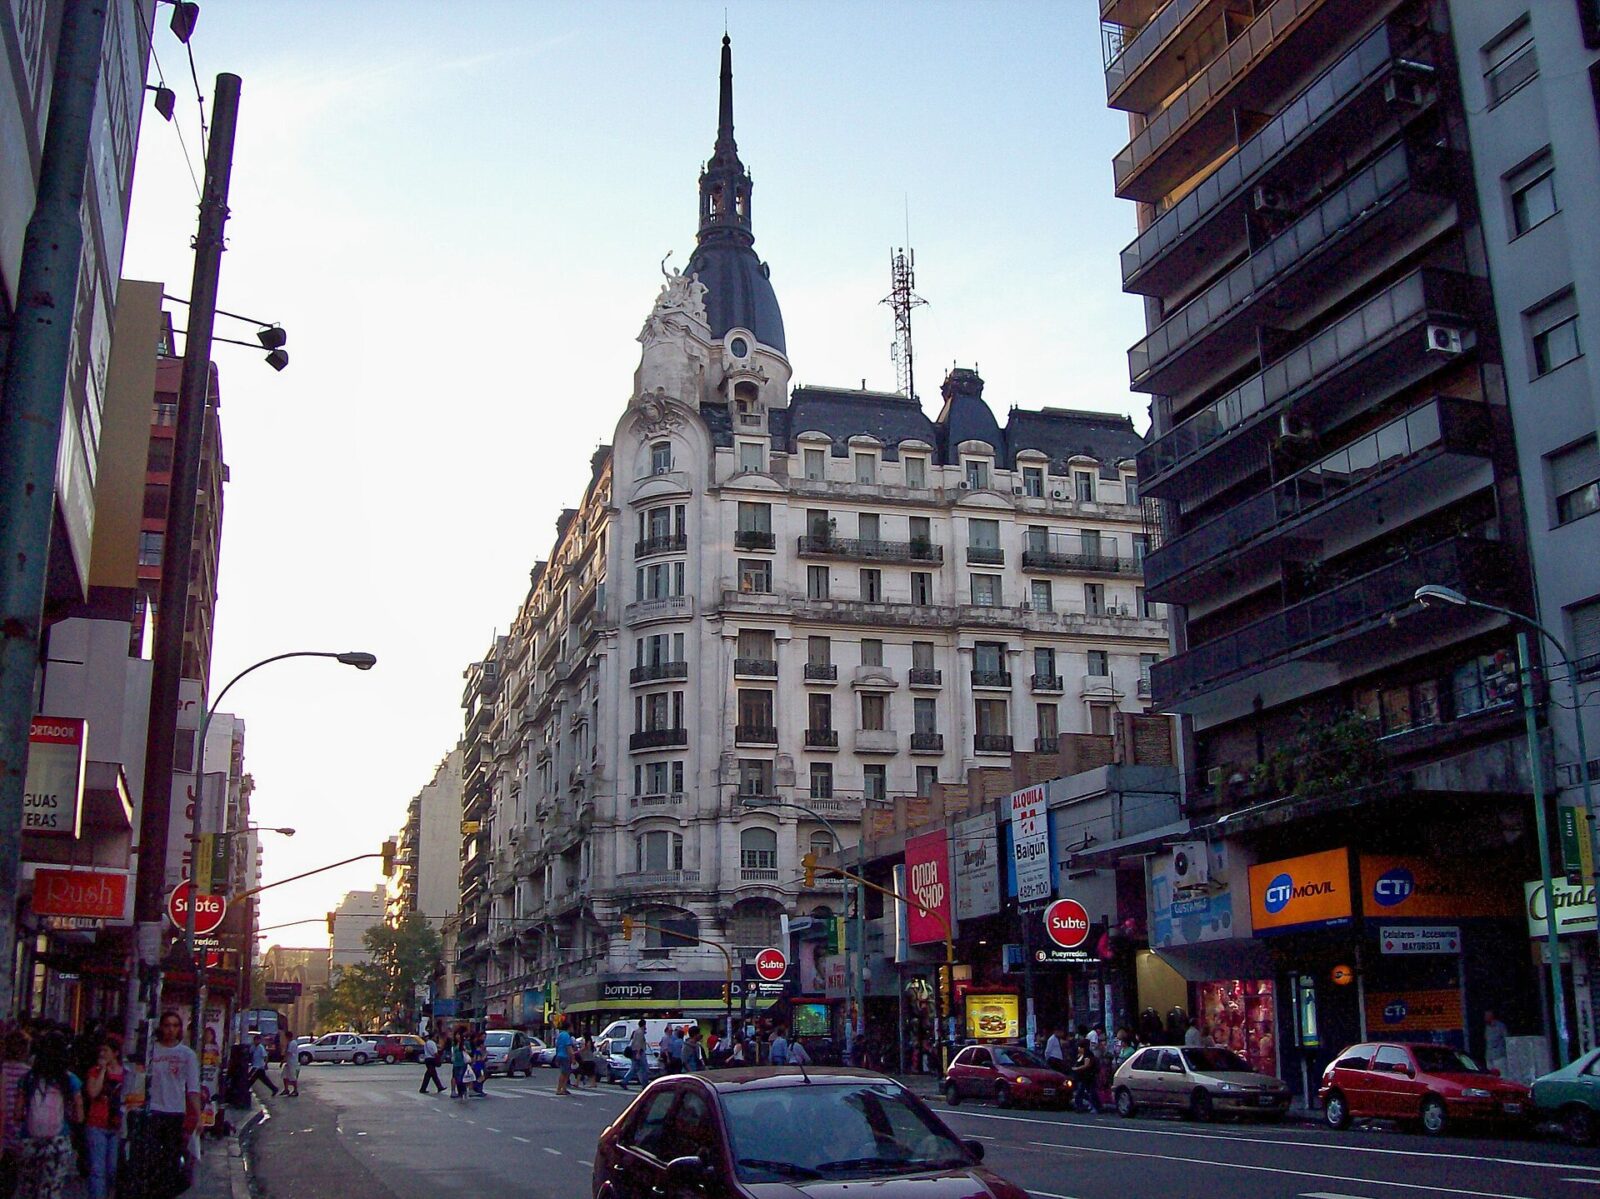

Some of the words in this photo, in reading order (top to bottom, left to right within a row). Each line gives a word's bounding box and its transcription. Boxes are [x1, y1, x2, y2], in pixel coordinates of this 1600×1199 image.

[1013, 788, 1043, 810] ALQUILA
[24, 813, 57, 827] ERAS
[911, 861, 938, 895] ONDA
[1292, 881, 1336, 899] MÓVIL
[918, 883, 945, 918] SHOP
[1053, 917, 1086, 929] Subte
[172, 937, 219, 945] Predón
[760, 961, 784, 969] Subte
[604, 983, 653, 997] bompie
